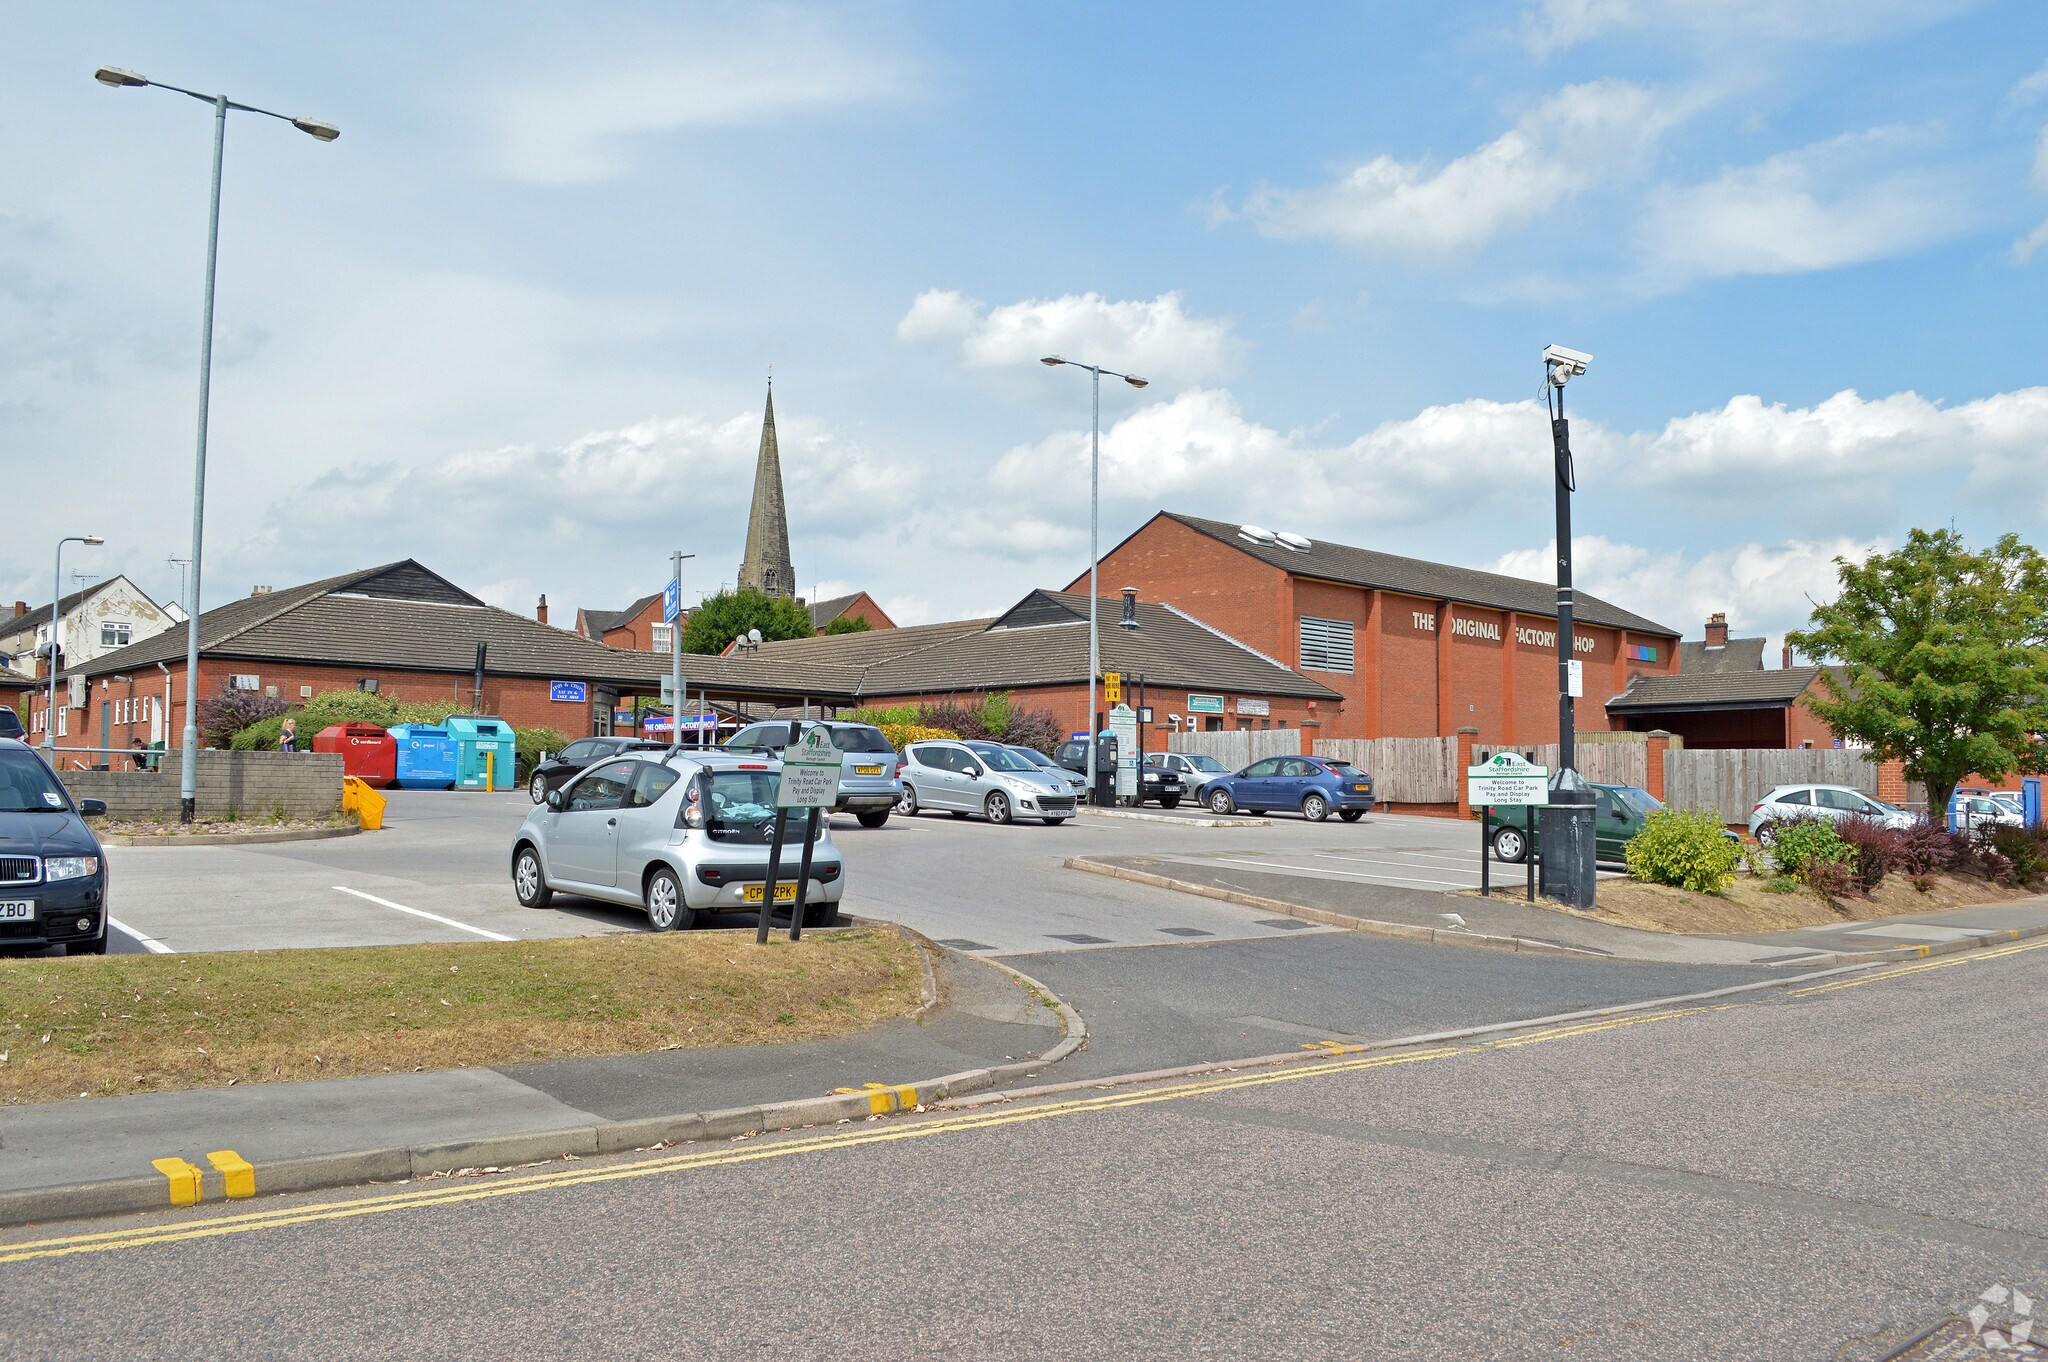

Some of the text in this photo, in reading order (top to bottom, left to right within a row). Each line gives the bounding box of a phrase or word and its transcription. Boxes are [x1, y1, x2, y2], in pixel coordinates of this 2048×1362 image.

[1412, 611, 1435, 631] THE
[1573, 636, 1595, 653] HOP
[681, 721, 700, 729] ACTORY
[703, 720, 714, 728] HOP
[820, 741, 830, 749] East
[801, 748, 831, 757] Staffordshire
[800, 769, 819, 777] Welcome
[788, 777, 802, 786] Trinity
[792, 787, 800, 795] Pay
[810, 787, 825, 795] Display
[797, 796, 818, 804] Long Stay
[774, 886, 792, 898] ZPK
